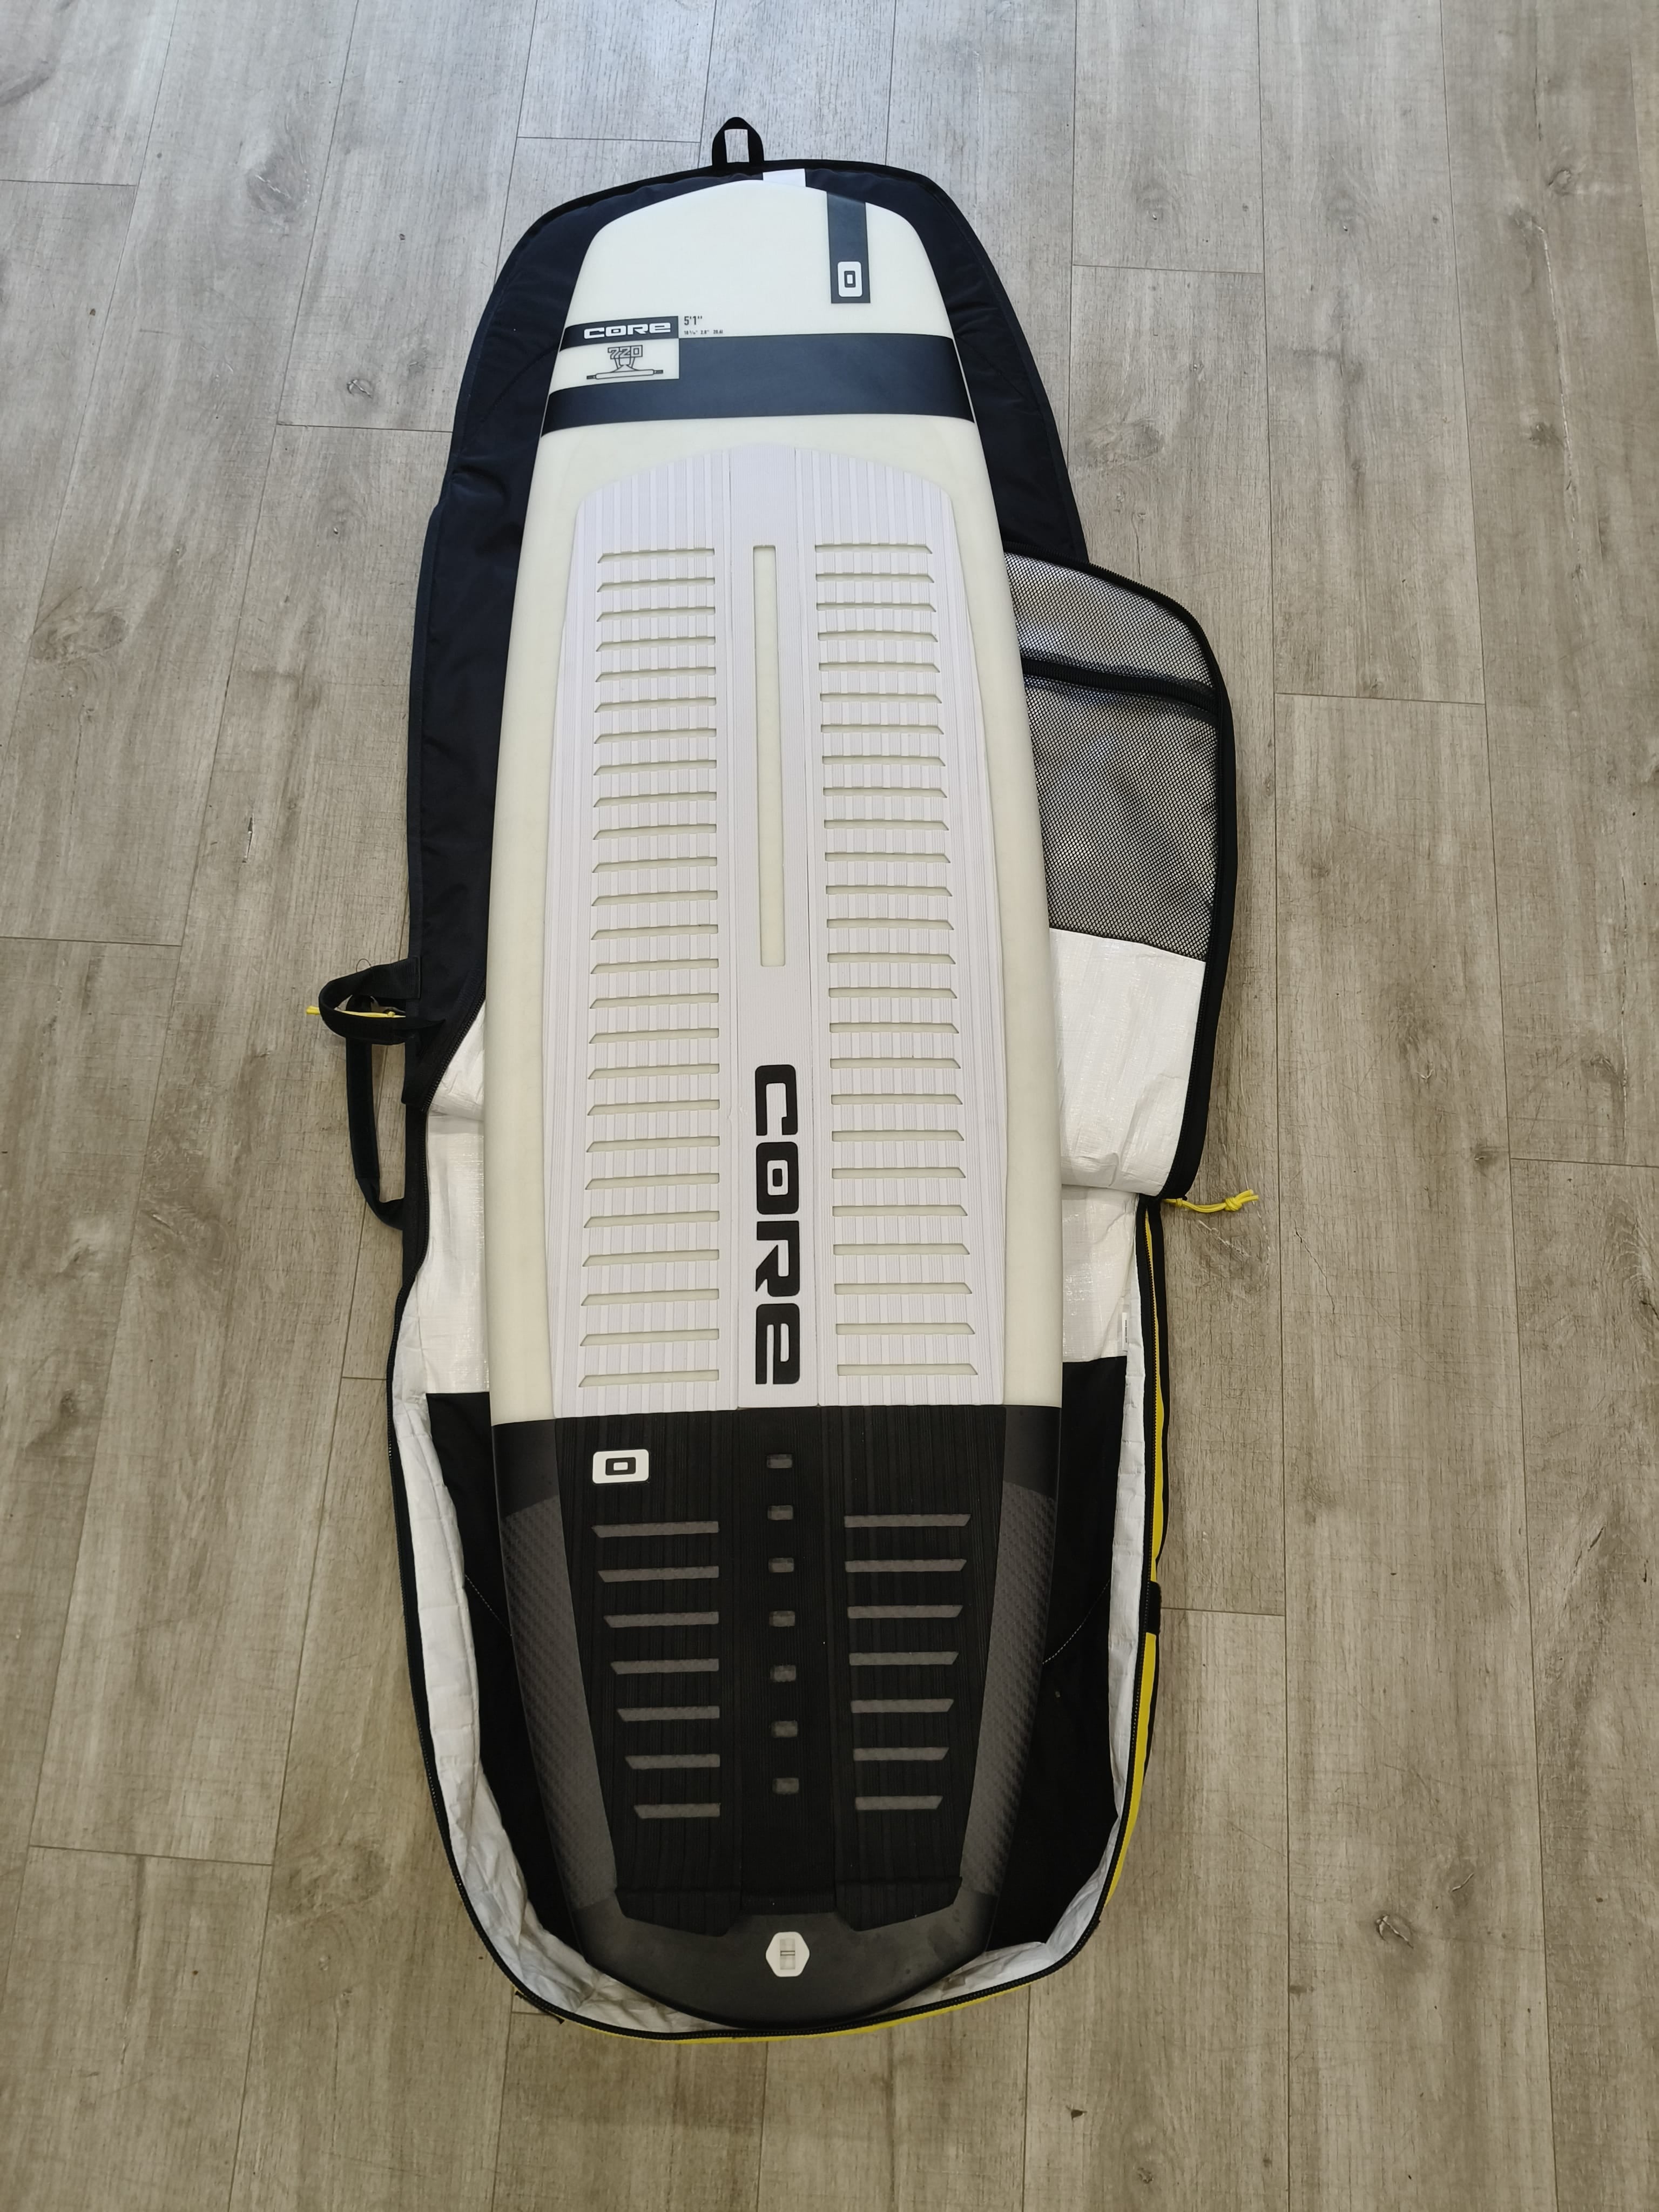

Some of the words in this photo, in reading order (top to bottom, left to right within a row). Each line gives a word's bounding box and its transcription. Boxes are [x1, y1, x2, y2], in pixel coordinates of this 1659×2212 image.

[584, 322, 671, 339] CORE
[608, 345, 643, 360] 720
[755, 1064, 800, 1385] CORE
